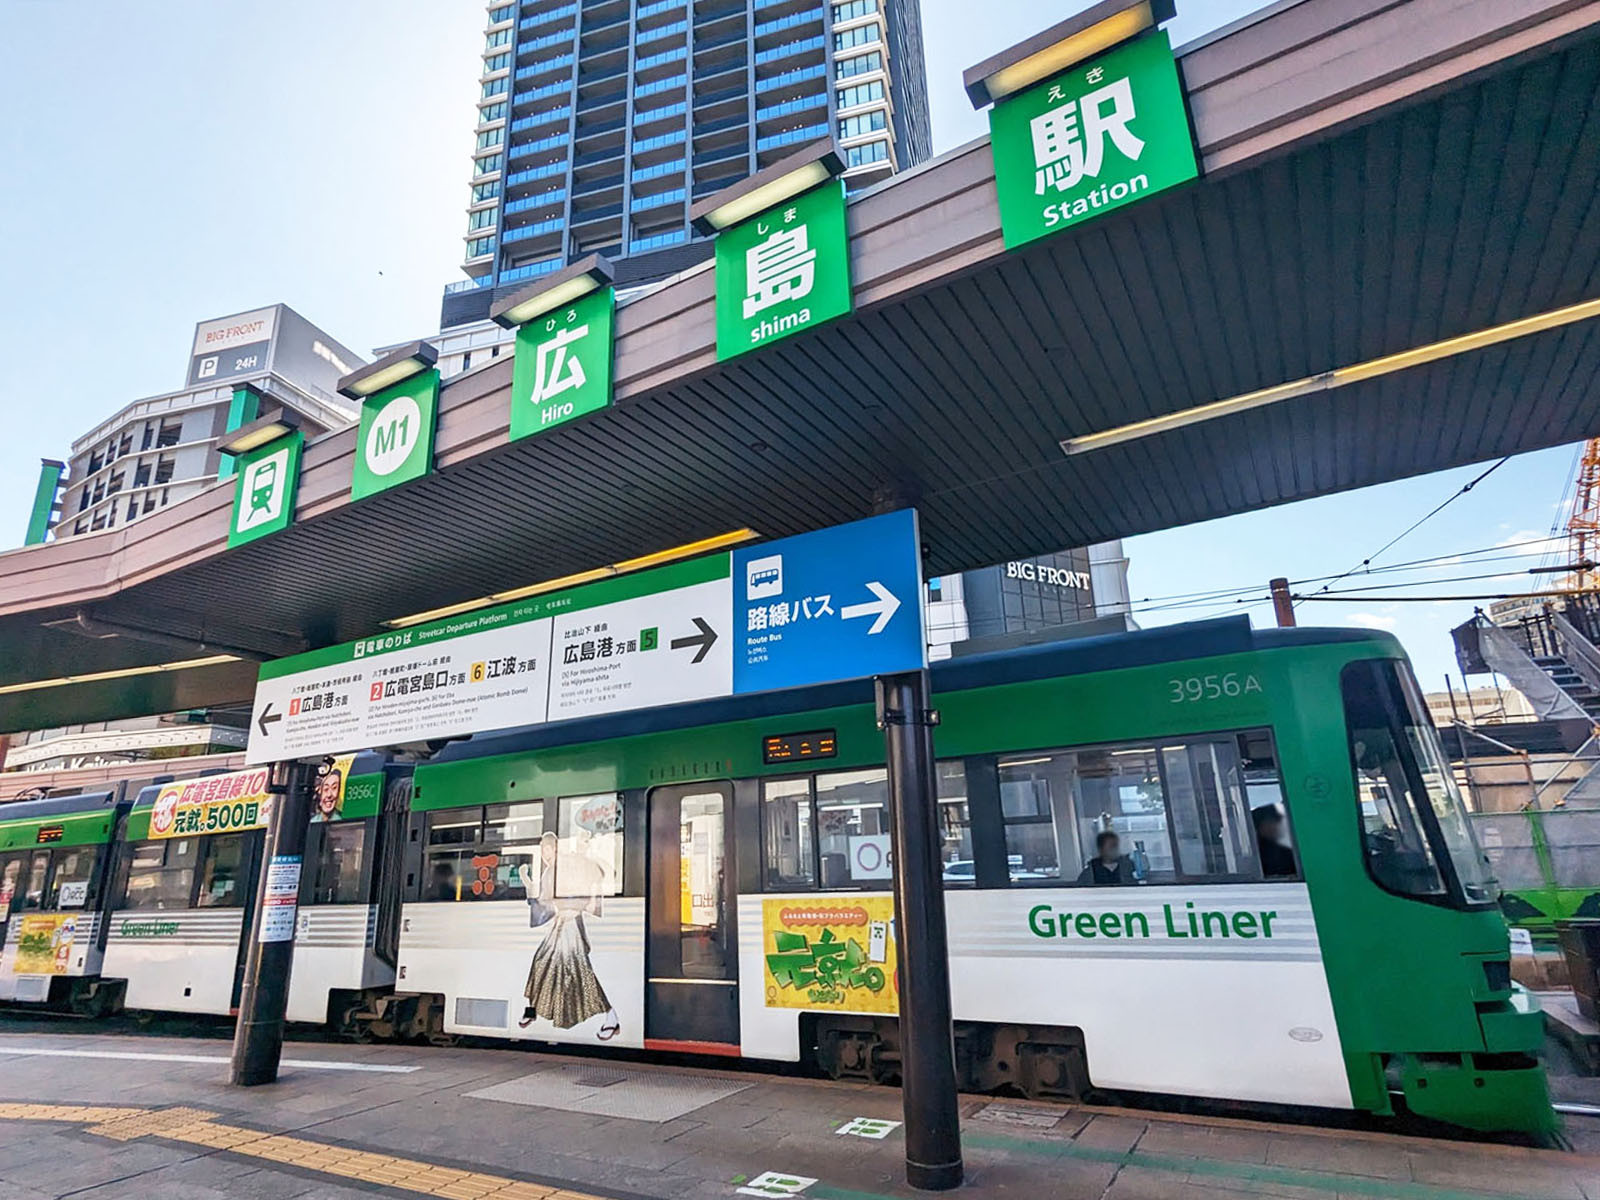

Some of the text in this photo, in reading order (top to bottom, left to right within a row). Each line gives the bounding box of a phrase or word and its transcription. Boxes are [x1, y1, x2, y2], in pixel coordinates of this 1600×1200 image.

[1029, 76, 1146, 195] 駅
[1042, 174, 1149, 227] Station
[756, 207, 798, 236] しま
[741, 223, 817, 320] 島
[205, 328, 225, 344] BIG
[225, 320, 265, 339] FRONT
[545, 308, 577, 332] ひろ
[750, 308, 811, 344] shima
[235, 355, 258, 371] 24H
[529, 323, 590, 405] 広
[541, 402, 574, 425] Hiro
[373, 414, 410, 458] M1
[1006, 560, 1037, 582] BIG
[1037, 562, 1090, 591] FRONT
[418, 613, 508, 640] Streetcar Departure Platform
[747, 594, 835, 631] 路線バス
[563, 630, 654, 665] 広島港方面 5
[747, 633, 783, 646] Route Bus
[384, 669, 466, 698] 広電宮島口方面
[486, 655, 537, 679] 江波方面
[1167, 672, 1263, 703] 3956A
[301, 691, 349, 713] 広島港方面
[346, 783, 376, 801] 3956C
[1028, 901, 1278, 938] Green Liner
